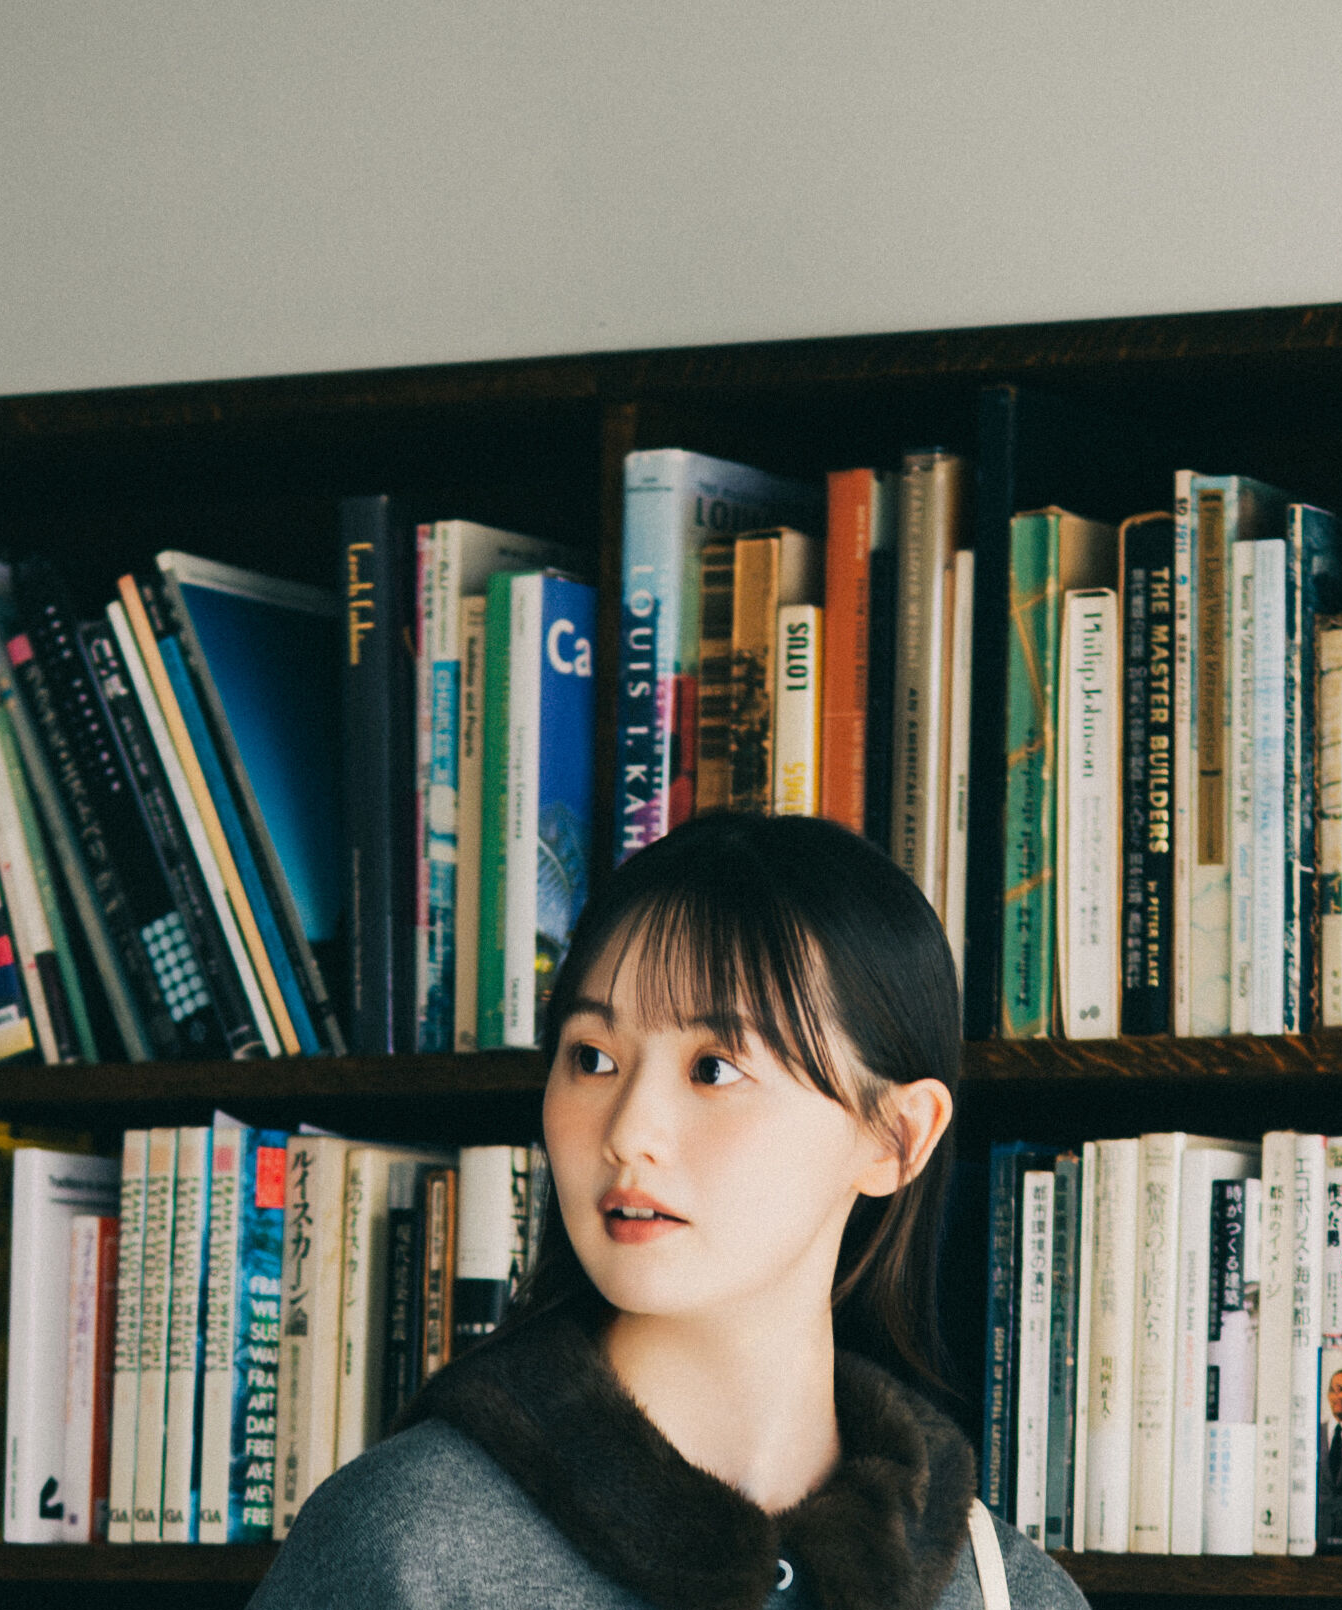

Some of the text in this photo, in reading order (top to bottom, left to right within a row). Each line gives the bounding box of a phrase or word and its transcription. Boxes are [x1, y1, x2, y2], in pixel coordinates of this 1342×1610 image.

[621, 564, 653, 850] LOUIS I. KAH
[786, 621, 808, 691] LOTUS
[907, 687, 918, 711] AN
[904, 720, 918, 805] AMERICAN
[1147, 567, 1168, 986] THE MASTER BUILDERS PETER BLAKE
[1225, 1185, 1242, 1308] 時がつくる建築
